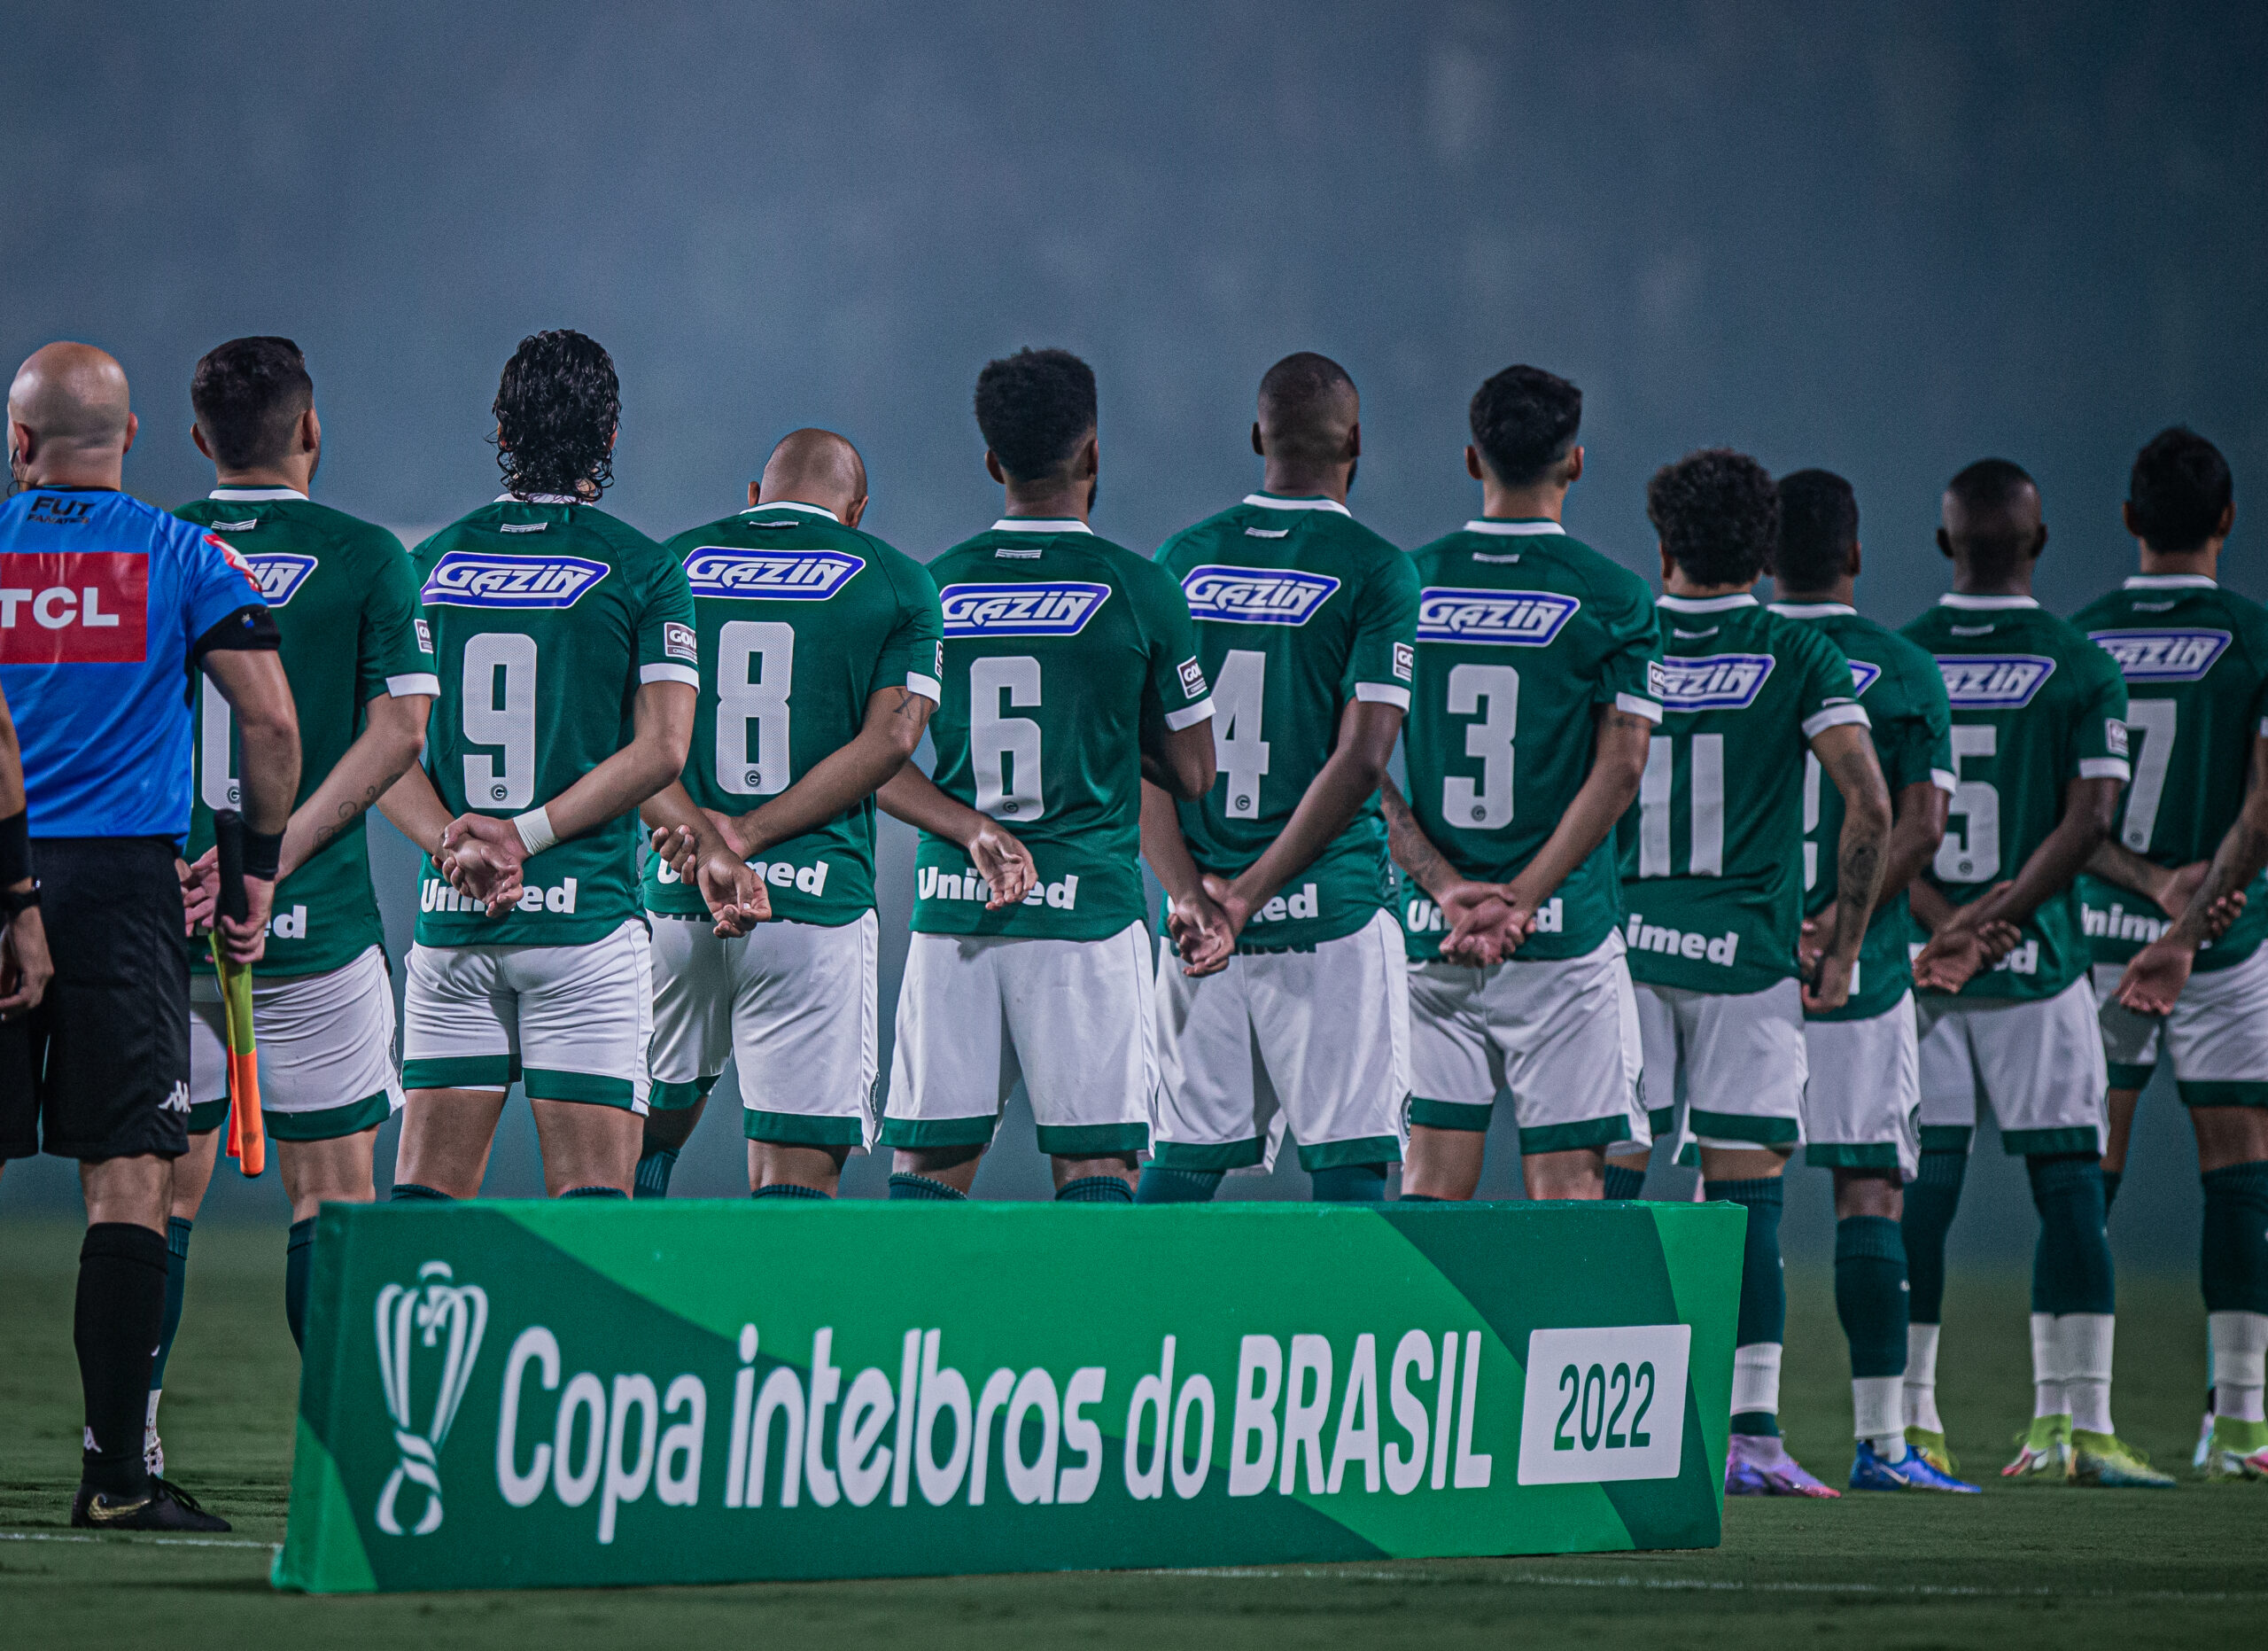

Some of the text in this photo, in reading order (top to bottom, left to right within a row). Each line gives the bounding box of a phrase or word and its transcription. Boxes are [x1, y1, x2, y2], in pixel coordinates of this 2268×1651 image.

[31, 496, 96, 516] FUT
[0, 586, 120, 629] TCL
[462, 633, 537, 809] 9
[716, 620, 795, 794] 8
[969, 656, 1045, 822] 6
[1210, 649, 1270, 820] 4
[1442, 664, 1519, 829] 3
[2121, 698, 2178, 853] 7
[1639, 733, 1724, 877] 11
[1933, 725, 2000, 884] 5
[1627, 913, 1739, 967] imed
[496, 1322, 1657, 1546] Copa intelbras do BRASIL 2022
